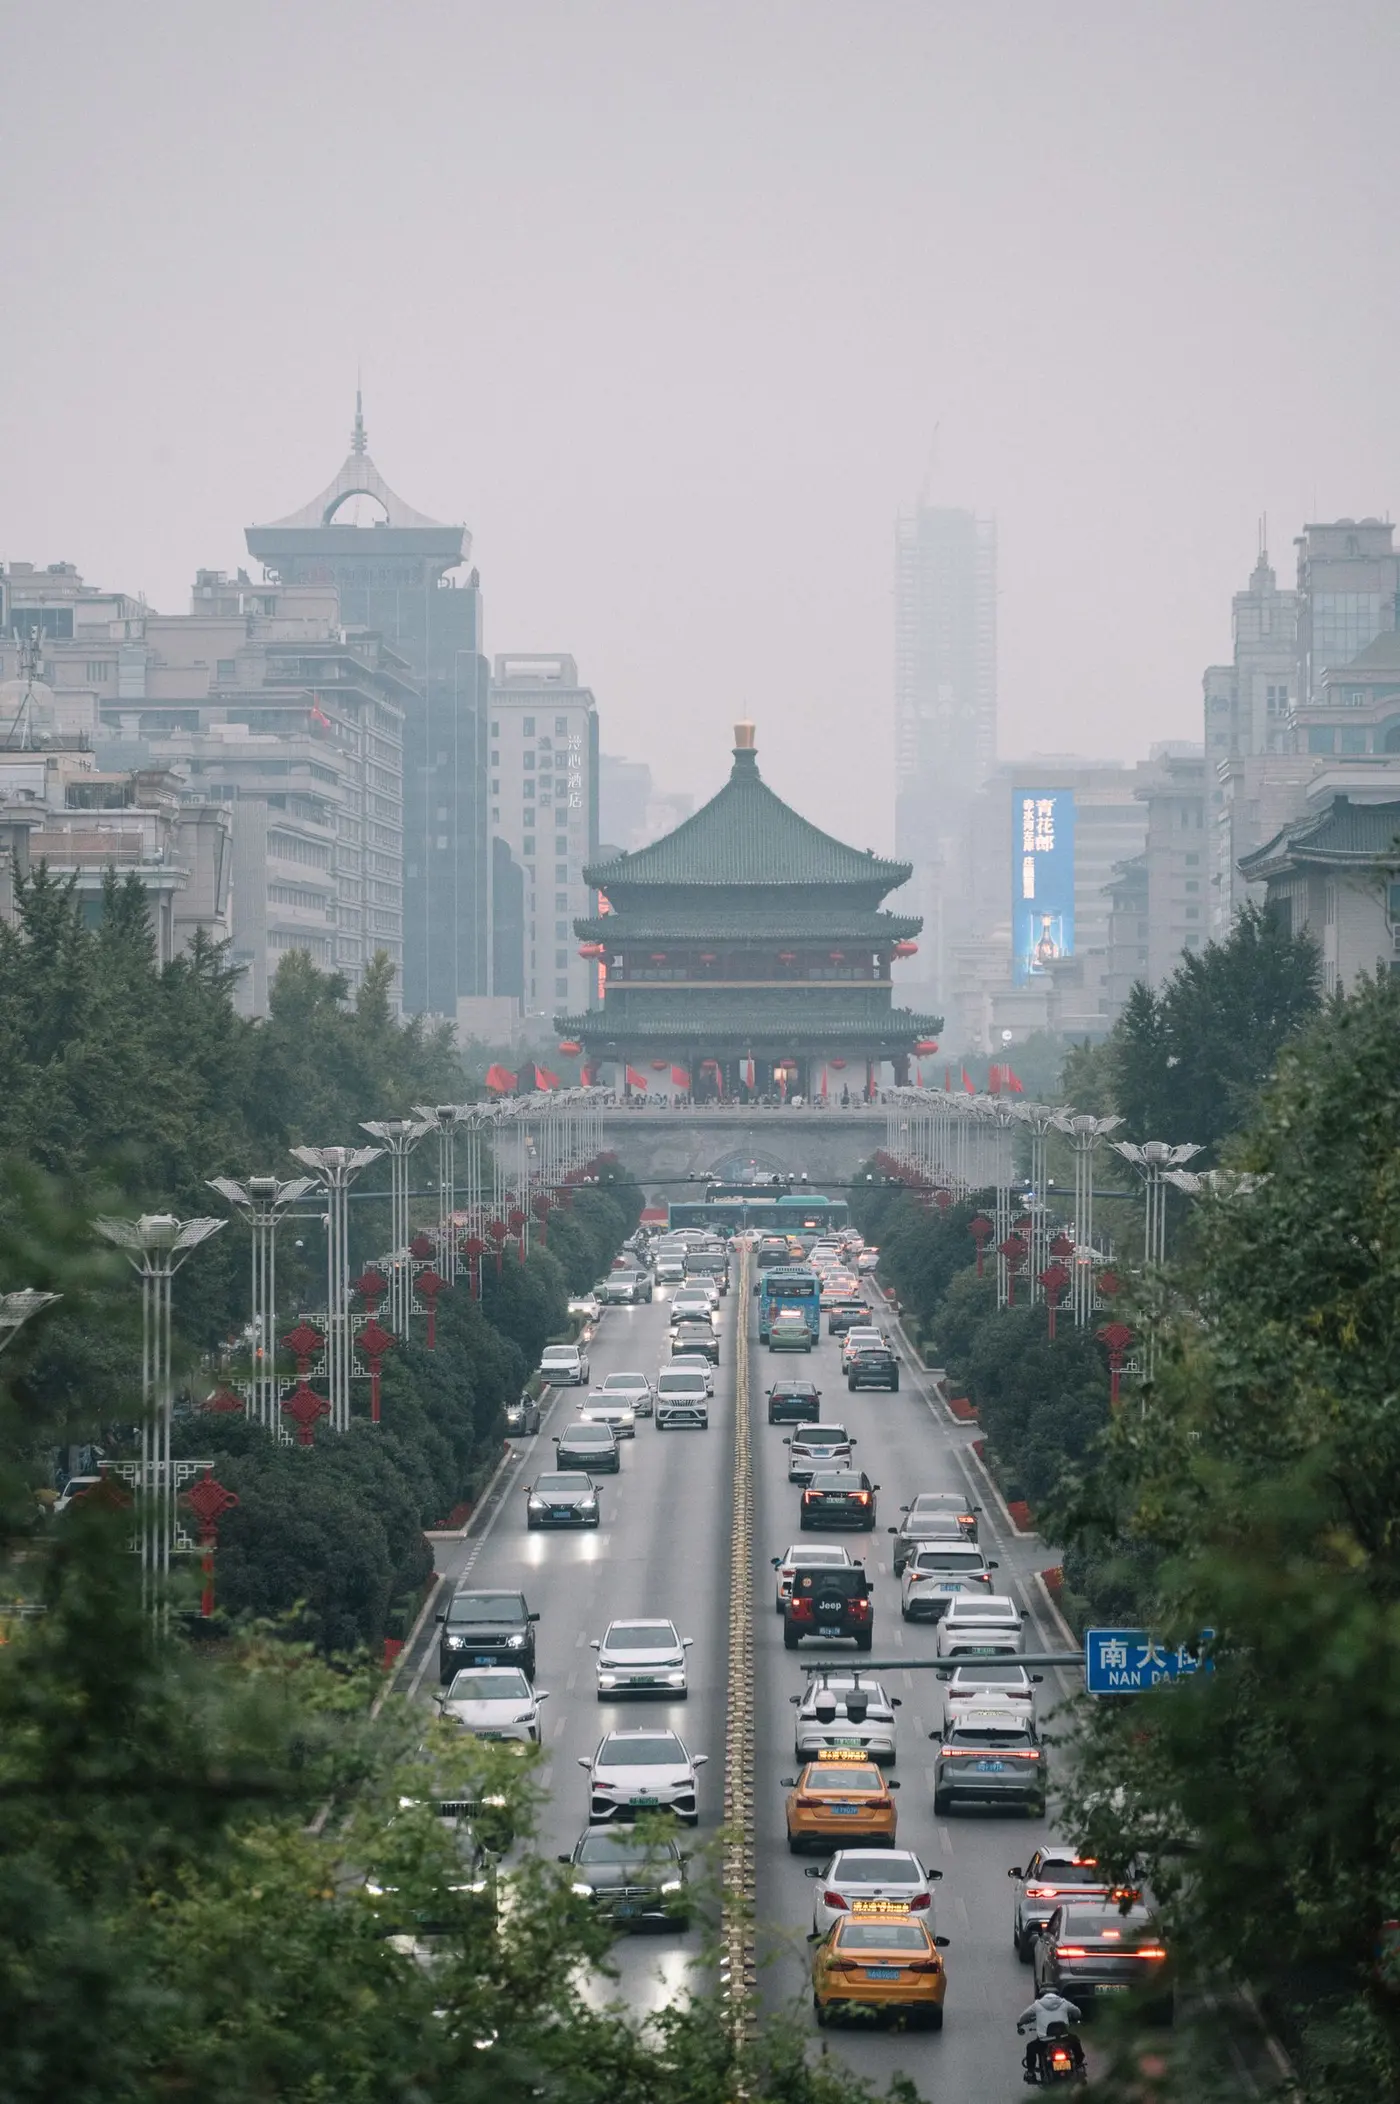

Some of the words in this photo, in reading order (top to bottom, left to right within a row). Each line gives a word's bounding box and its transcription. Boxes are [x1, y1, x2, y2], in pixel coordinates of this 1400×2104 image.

[1035, 799, 1054, 852] 青花郎
[819, 1601, 841, 1611] Jeep
[1109, 1671, 1141, 1686] NAN
